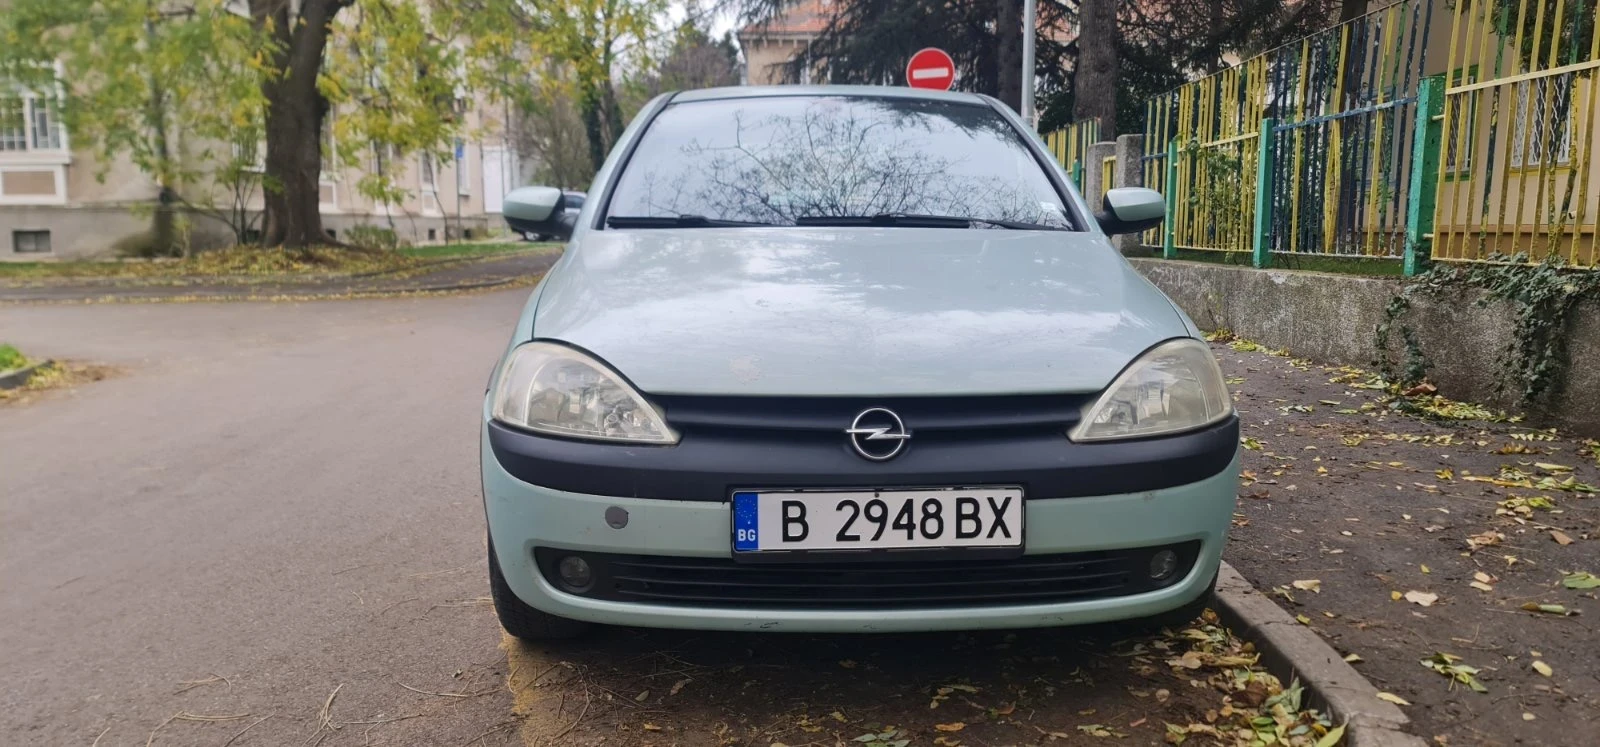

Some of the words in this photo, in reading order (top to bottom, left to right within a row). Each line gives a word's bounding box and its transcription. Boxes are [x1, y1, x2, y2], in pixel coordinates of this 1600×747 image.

[782, 500, 809, 542] B
[835, 498, 944, 541] 2948
[955, 496, 1012, 539] BX
[737, 529, 756, 542] BG
